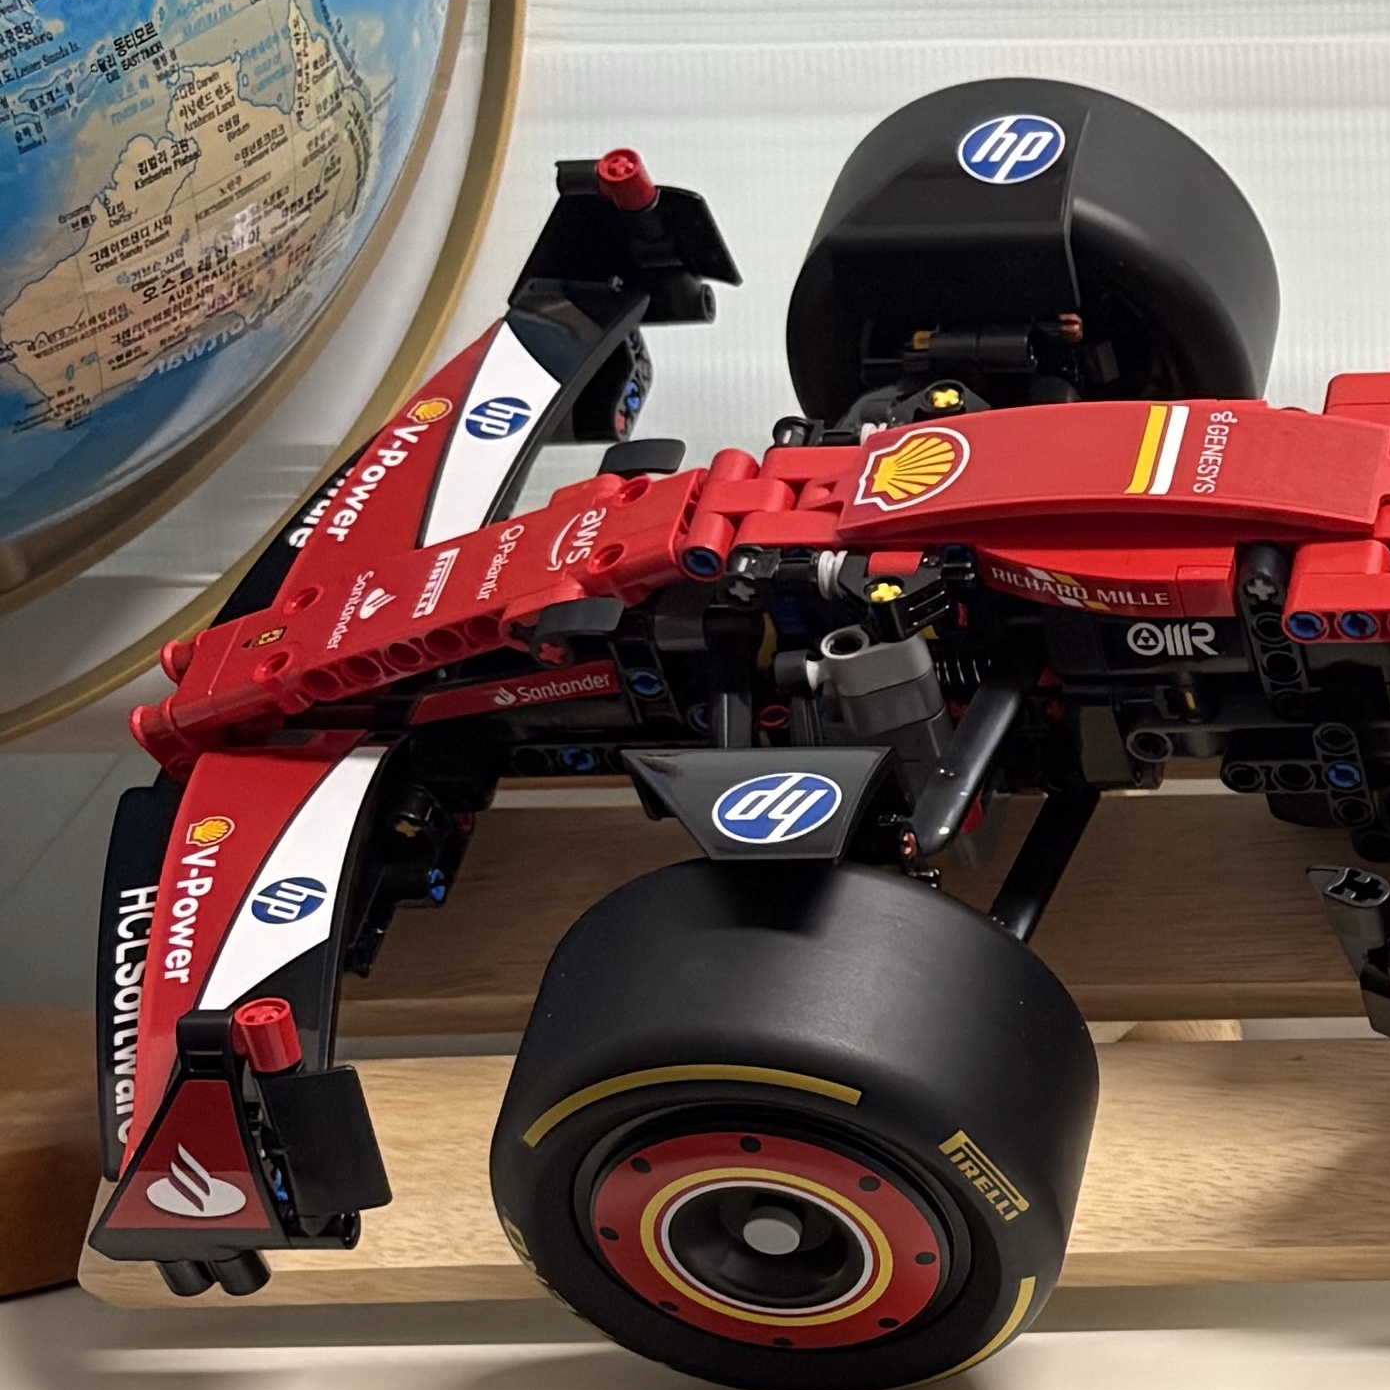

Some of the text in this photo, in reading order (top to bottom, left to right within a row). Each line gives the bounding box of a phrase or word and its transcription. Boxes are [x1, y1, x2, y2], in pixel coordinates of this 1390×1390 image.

[114, 21, 158, 56] 동티모르
[959, 114, 1065, 184] hp
[167, 259, 238, 303] AUSTRALIA
[465, 396, 533, 440] hp
[327, 423, 429, 542] V-Power
[1192, 424, 1231, 495] GENESYS
[566, 508, 607, 564] aws
[326, 569, 375, 652] Santander
[412, 548, 461, 619] PIRELLI
[992, 567, 1171, 606] RICHARD MILLE
[516, 670, 613, 703] Santander
[164, 845, 219, 984] V-Power
[251, 877, 327, 925] hp
[938, 1130, 1031, 1222] PIRELLI
